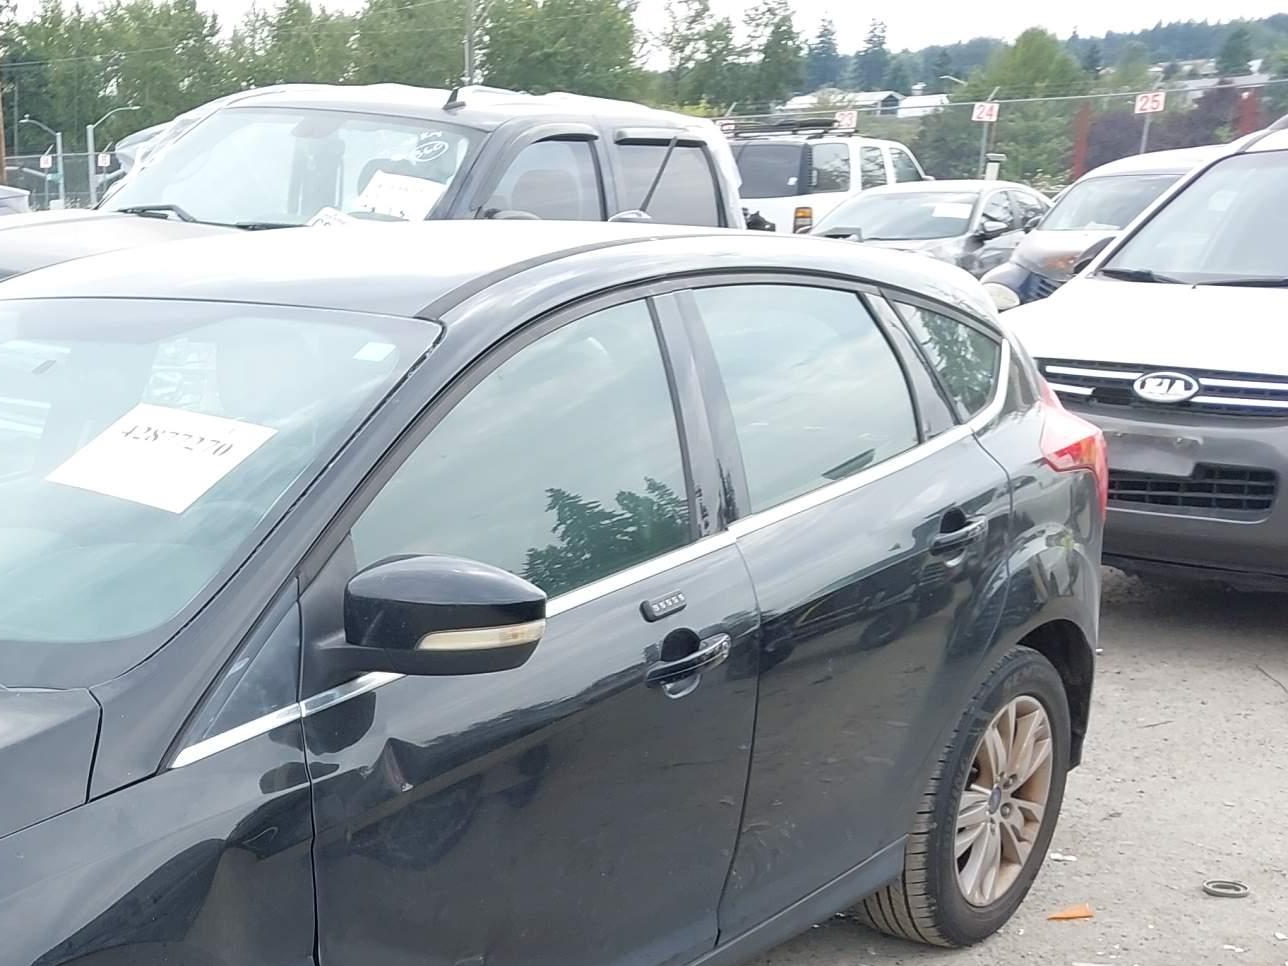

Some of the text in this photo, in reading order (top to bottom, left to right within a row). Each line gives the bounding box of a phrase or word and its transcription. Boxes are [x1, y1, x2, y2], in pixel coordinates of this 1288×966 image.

[1139, 95, 1161, 112] 25
[976, 106, 995, 120] 24
[1140, 376, 1190, 396] KIA
